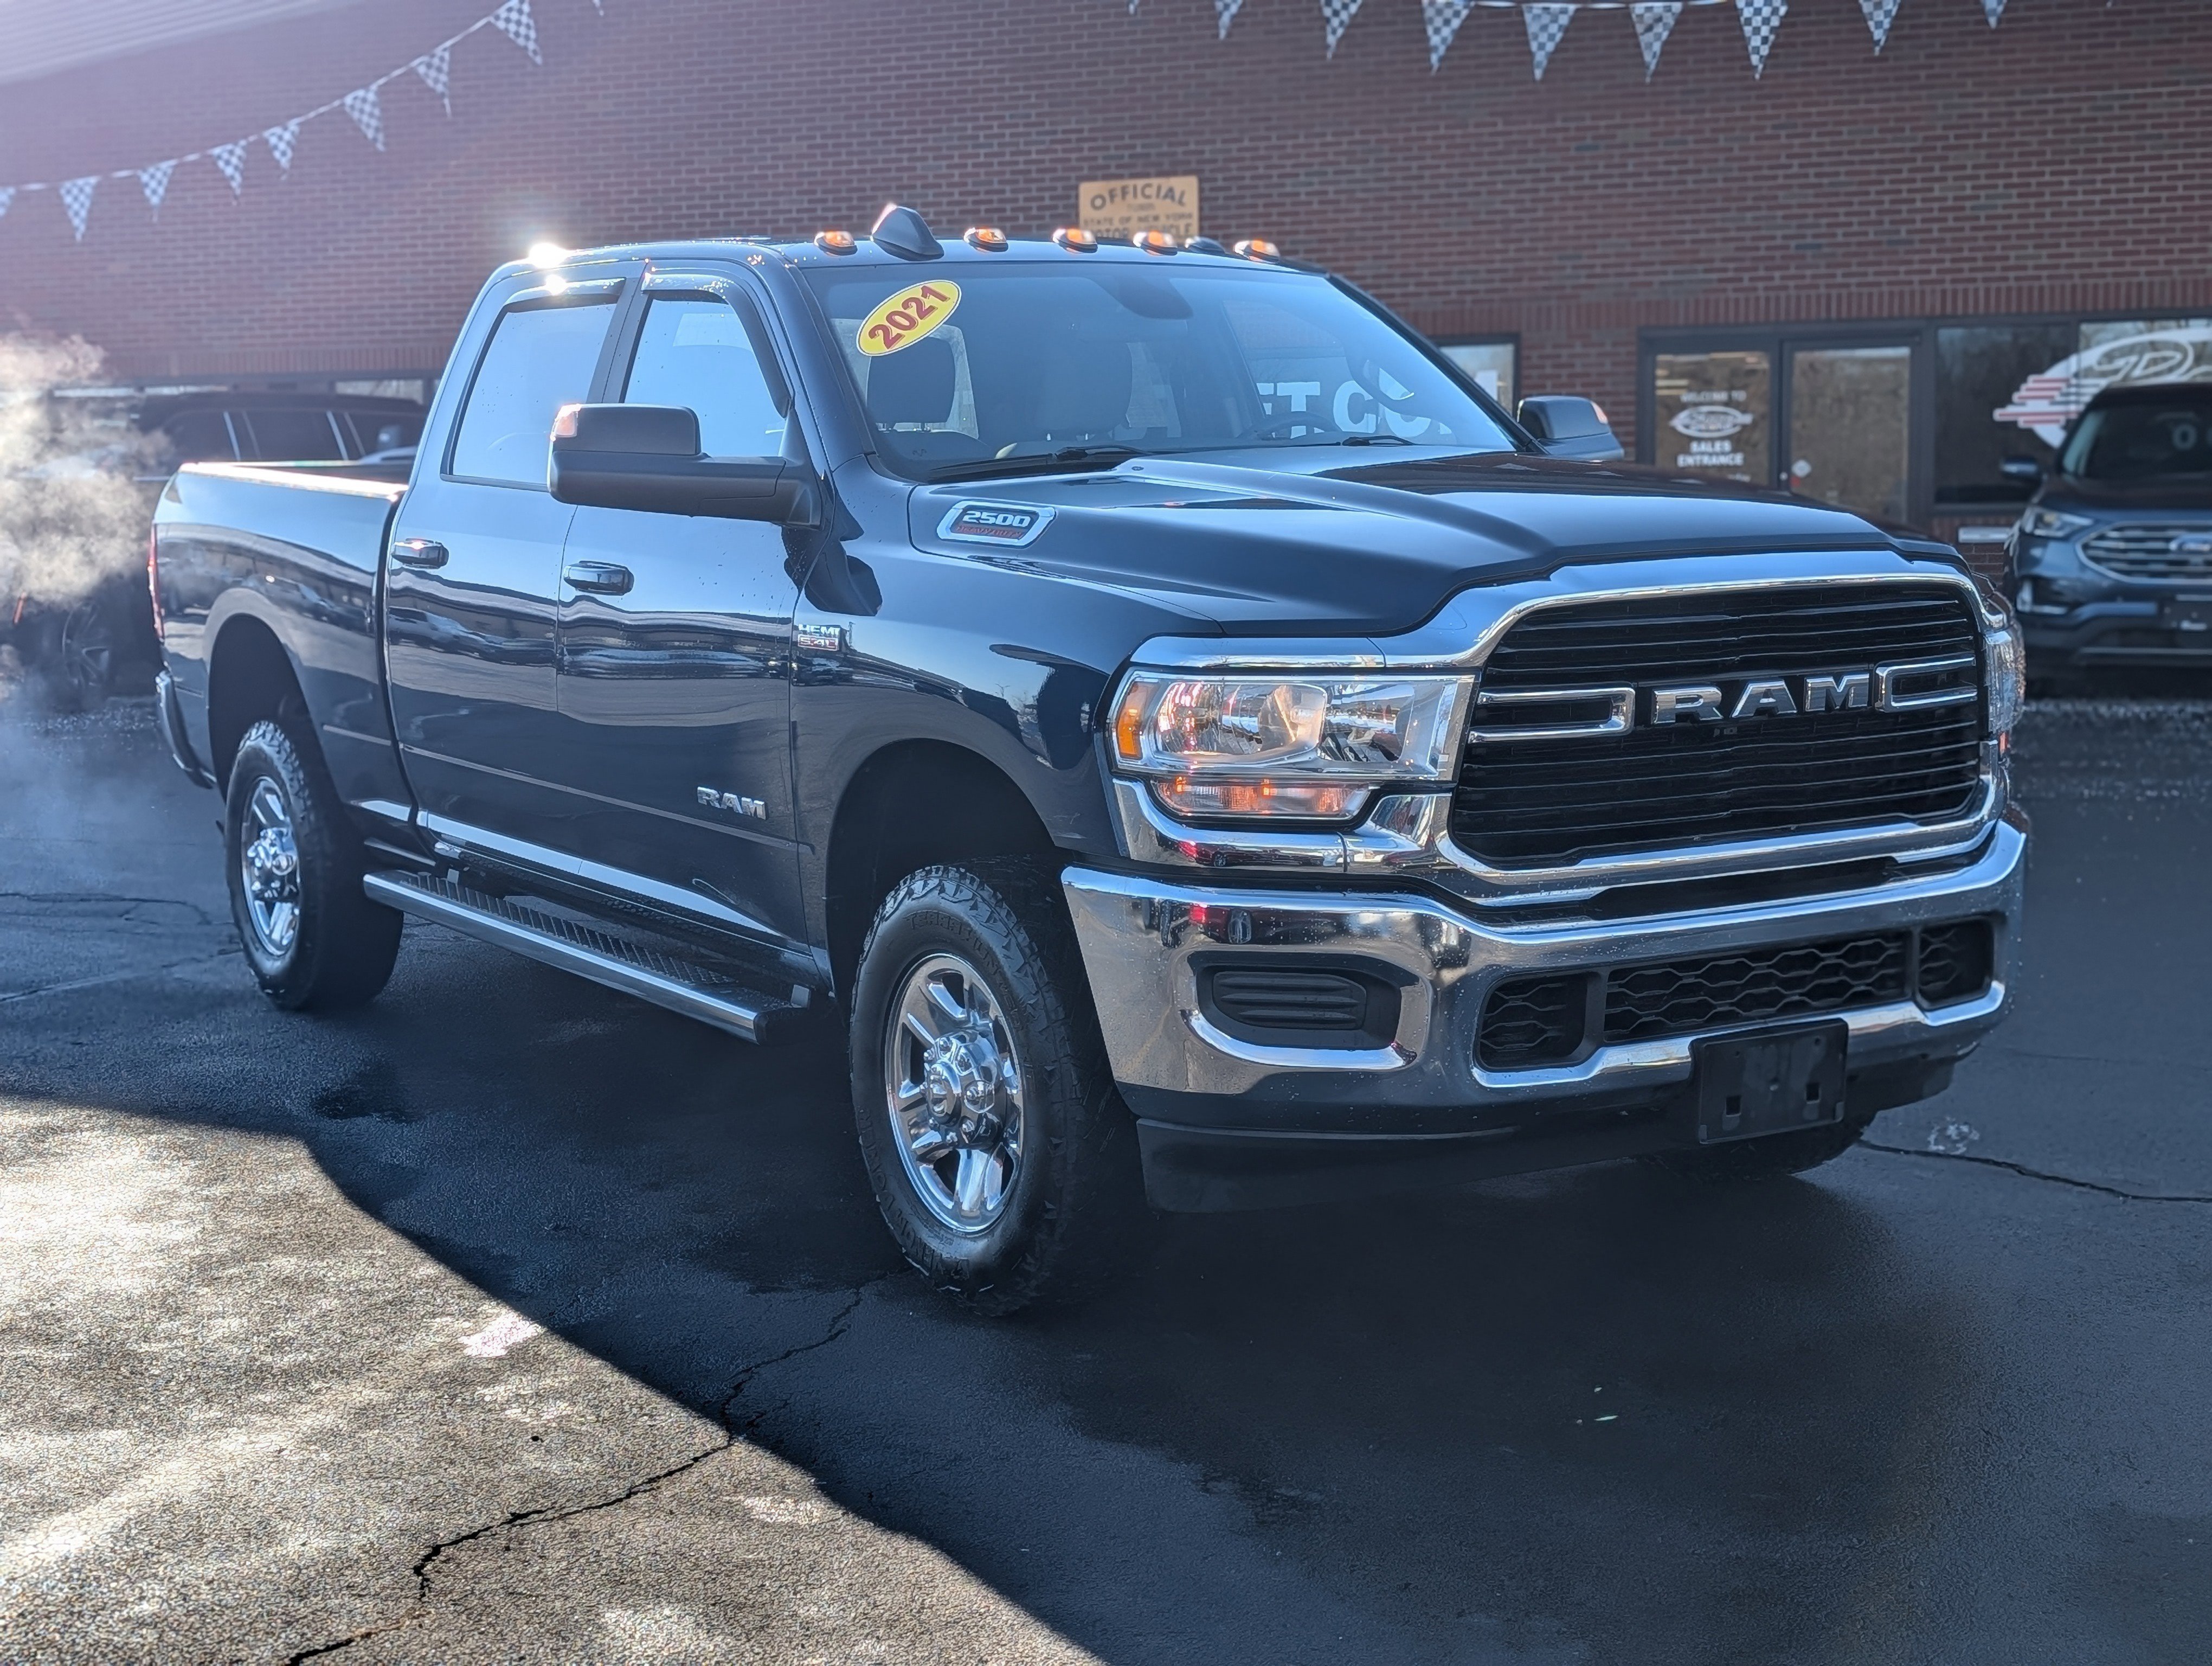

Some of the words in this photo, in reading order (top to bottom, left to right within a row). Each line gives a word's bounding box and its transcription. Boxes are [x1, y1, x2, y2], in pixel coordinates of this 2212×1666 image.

[1090, 183, 1186, 210] OFFICIAL
[869, 285, 950, 350] 2021
[1690, 440, 1732, 453] SALES
[1676, 452, 1744, 468] ENTRANCE
[962, 510, 1031, 527] 2500
[799, 624, 840, 637] HEMI
[1651, 672, 1870, 725] RAM
[697, 786, 767, 820] RAM
